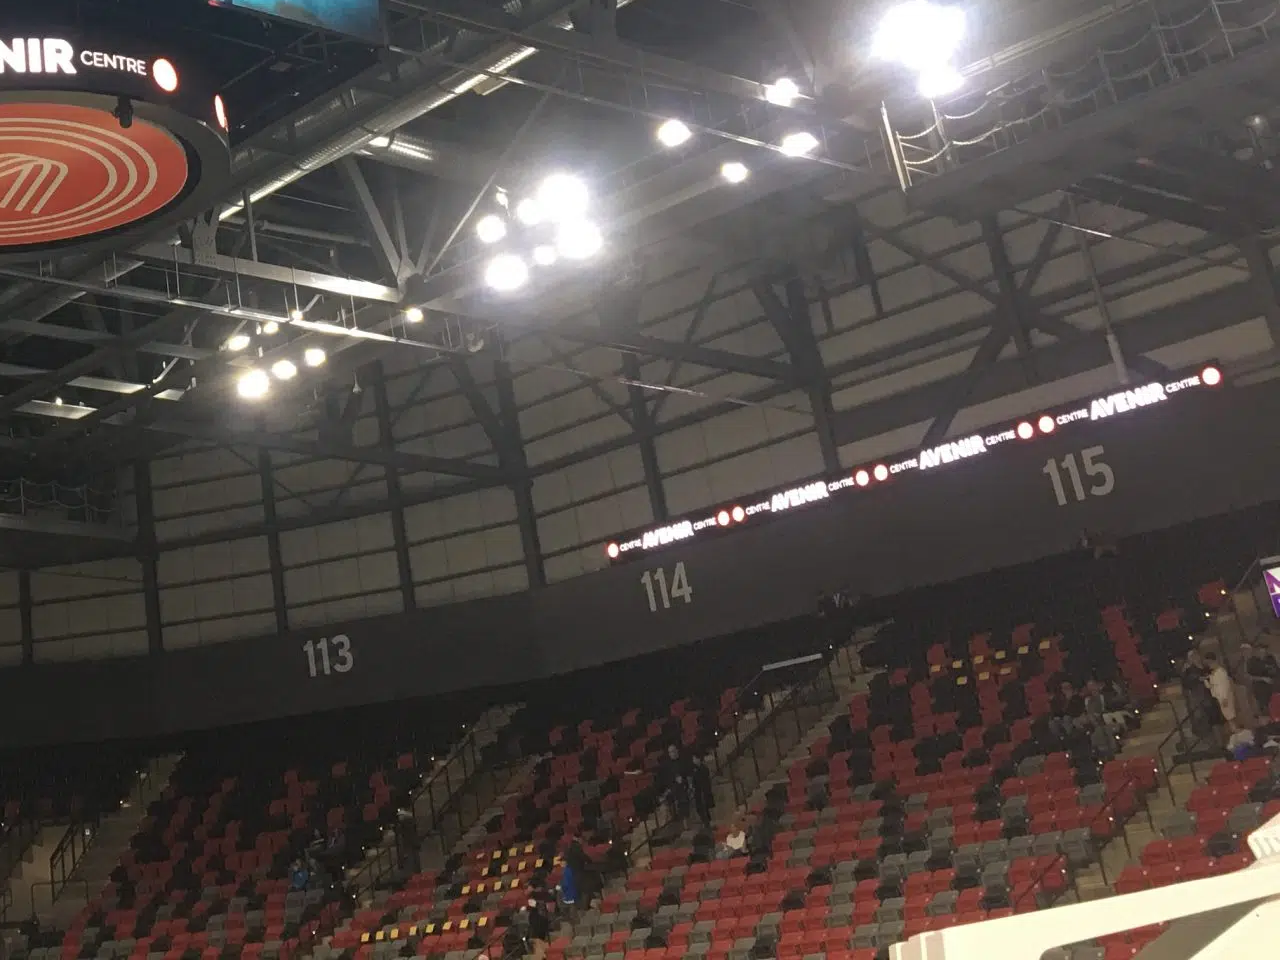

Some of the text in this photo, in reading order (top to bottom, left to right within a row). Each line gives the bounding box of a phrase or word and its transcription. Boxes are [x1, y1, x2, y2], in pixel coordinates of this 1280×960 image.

[80, 51, 147, 77] CENTRE
[1056, 376, 1200, 425] CENTRE AVENIR CENTRE
[890, 429, 1016, 474] CENTRE AVENIR CENTRE
[745, 476, 854, 515] CENTRE AVENIR CENTRE
[1043, 445, 1115, 506] 115
[642, 520, 695, 549] AVENIR
[640, 562, 693, 612] 114
[303, 634, 354, 677] 113
